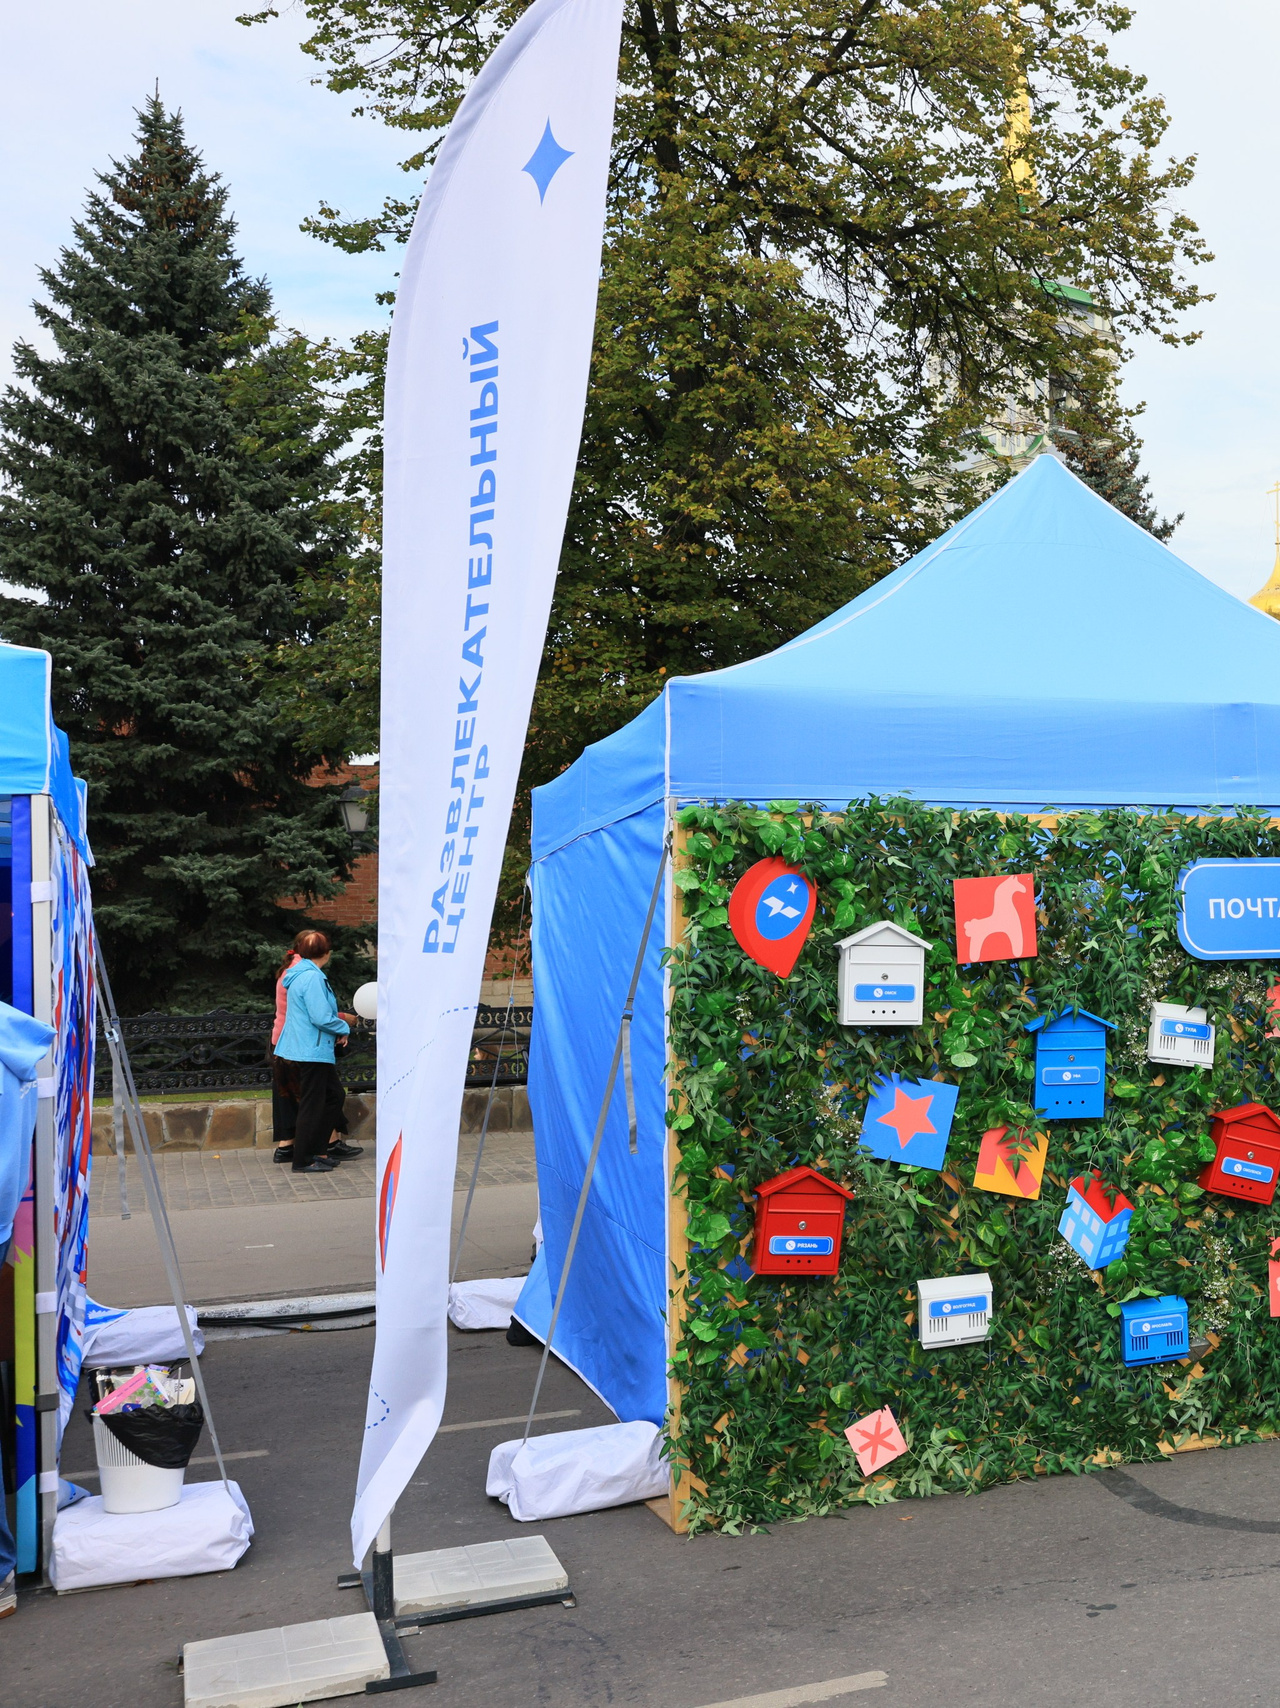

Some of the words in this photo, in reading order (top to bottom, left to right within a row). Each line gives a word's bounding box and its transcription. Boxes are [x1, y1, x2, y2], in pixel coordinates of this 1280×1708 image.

[421, 319, 500, 954] РАЗВЛЕКАТЕЛЬНЫЙ
[440, 743, 492, 954] ЦЕНТР
[951, 1301, 977, 1310] ВОЛГОГРАД
